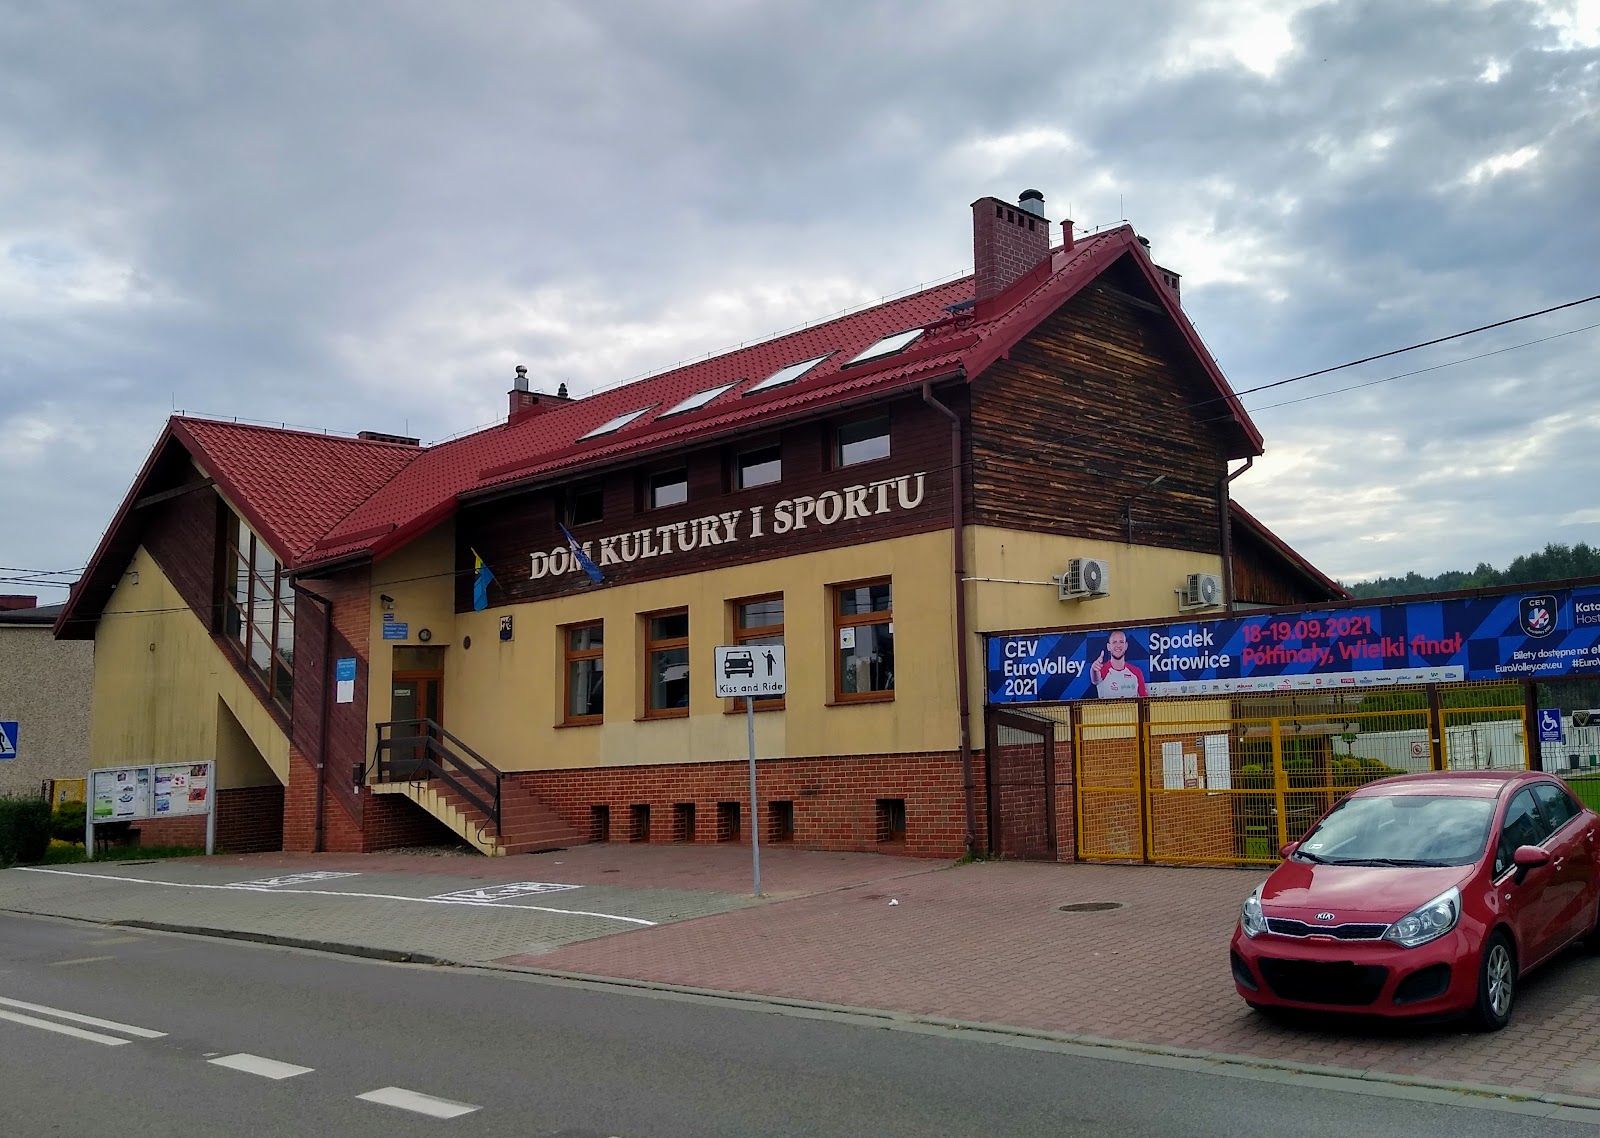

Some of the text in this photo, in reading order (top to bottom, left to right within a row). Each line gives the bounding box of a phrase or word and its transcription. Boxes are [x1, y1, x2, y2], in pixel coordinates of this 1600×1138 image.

[530, 471, 927, 580] DOM KULTURY I SPORTU
[1242, 615, 1371, 644] 18-19.09.2021
[1004, 640, 1039, 658] CEV
[1148, 628, 1214, 654] Spodek
[1242, 632, 1463, 667] Półfinały, Wielki finał
[1149, 650, 1230, 672] Katowice
[1513, 644, 1600, 660] Bilety dostępne na e
[1004, 656, 1085, 677] EuroVolley
[1495, 661, 1562, 673] EuroVolley.cev.eu
[719, 682, 783, 693] Kiss and Ride
[1004, 678, 1038, 696] 2021
[1316, 912, 1332, 920] KIA
